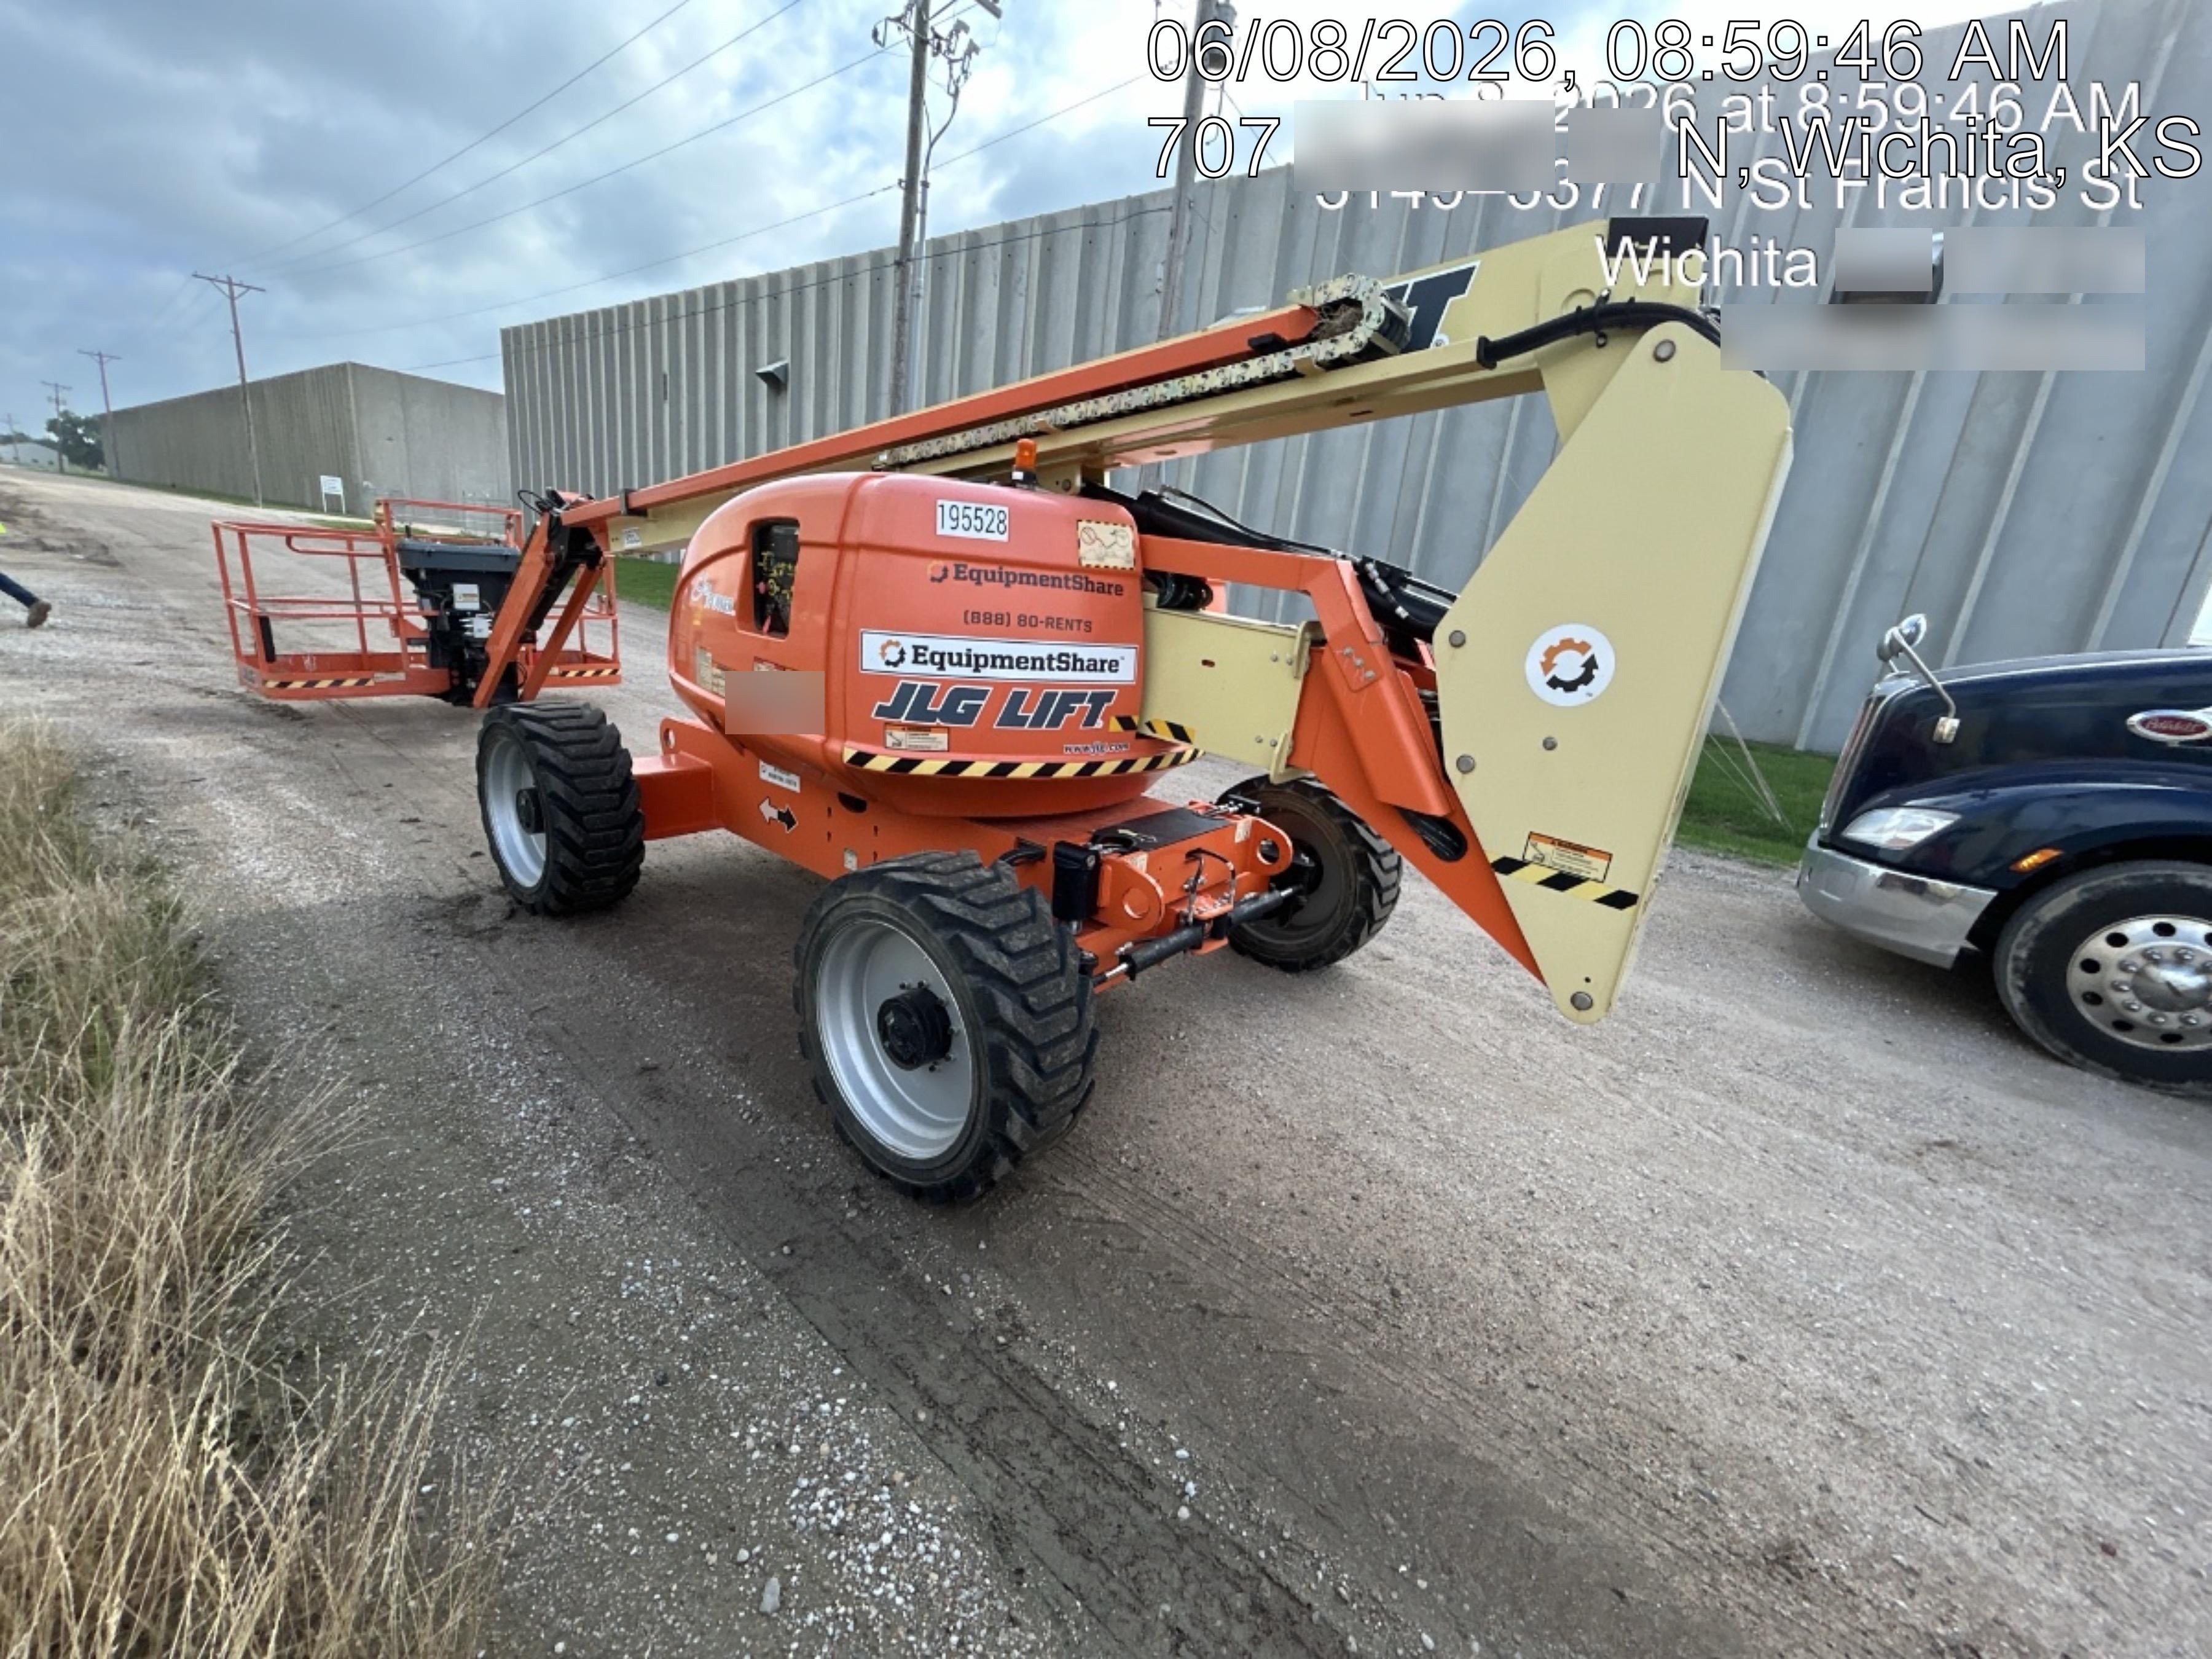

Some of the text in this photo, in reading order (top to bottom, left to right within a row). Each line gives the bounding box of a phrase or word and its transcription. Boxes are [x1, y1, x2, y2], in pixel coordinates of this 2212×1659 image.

[938, 504, 1008, 536] 195528
[953, 563, 1124, 596] EquipmentShare
[963, 610, 1092, 633] (888) 80-RENTS
[911, 645, 1120, 673] EquipmentShare
[871, 680, 1119, 730] JLG LIFT
